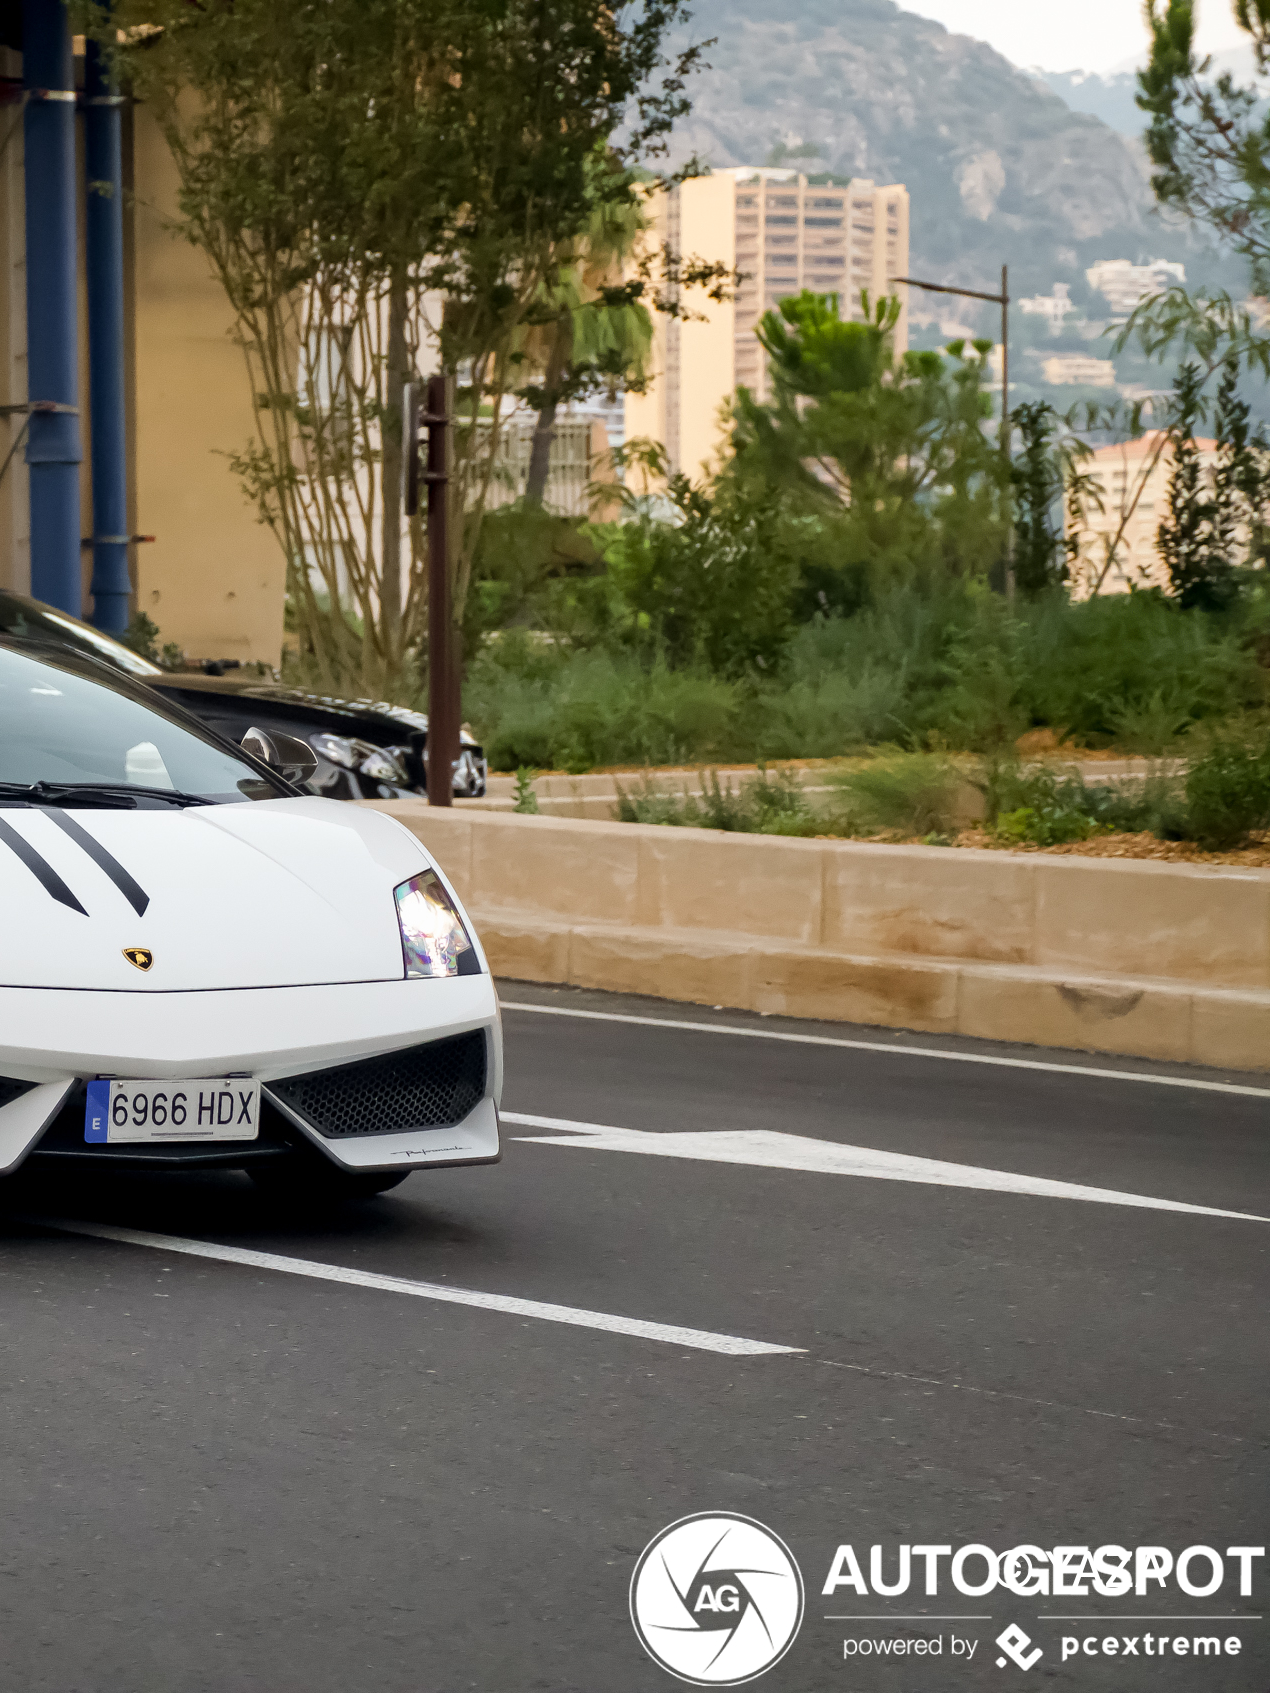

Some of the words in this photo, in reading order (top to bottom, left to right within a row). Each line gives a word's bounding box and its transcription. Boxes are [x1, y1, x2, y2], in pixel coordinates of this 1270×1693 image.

[112, 1092, 188, 1127] 6966
[197, 1091, 254, 1126] HDX
[92, 1117, 101, 1130] E
